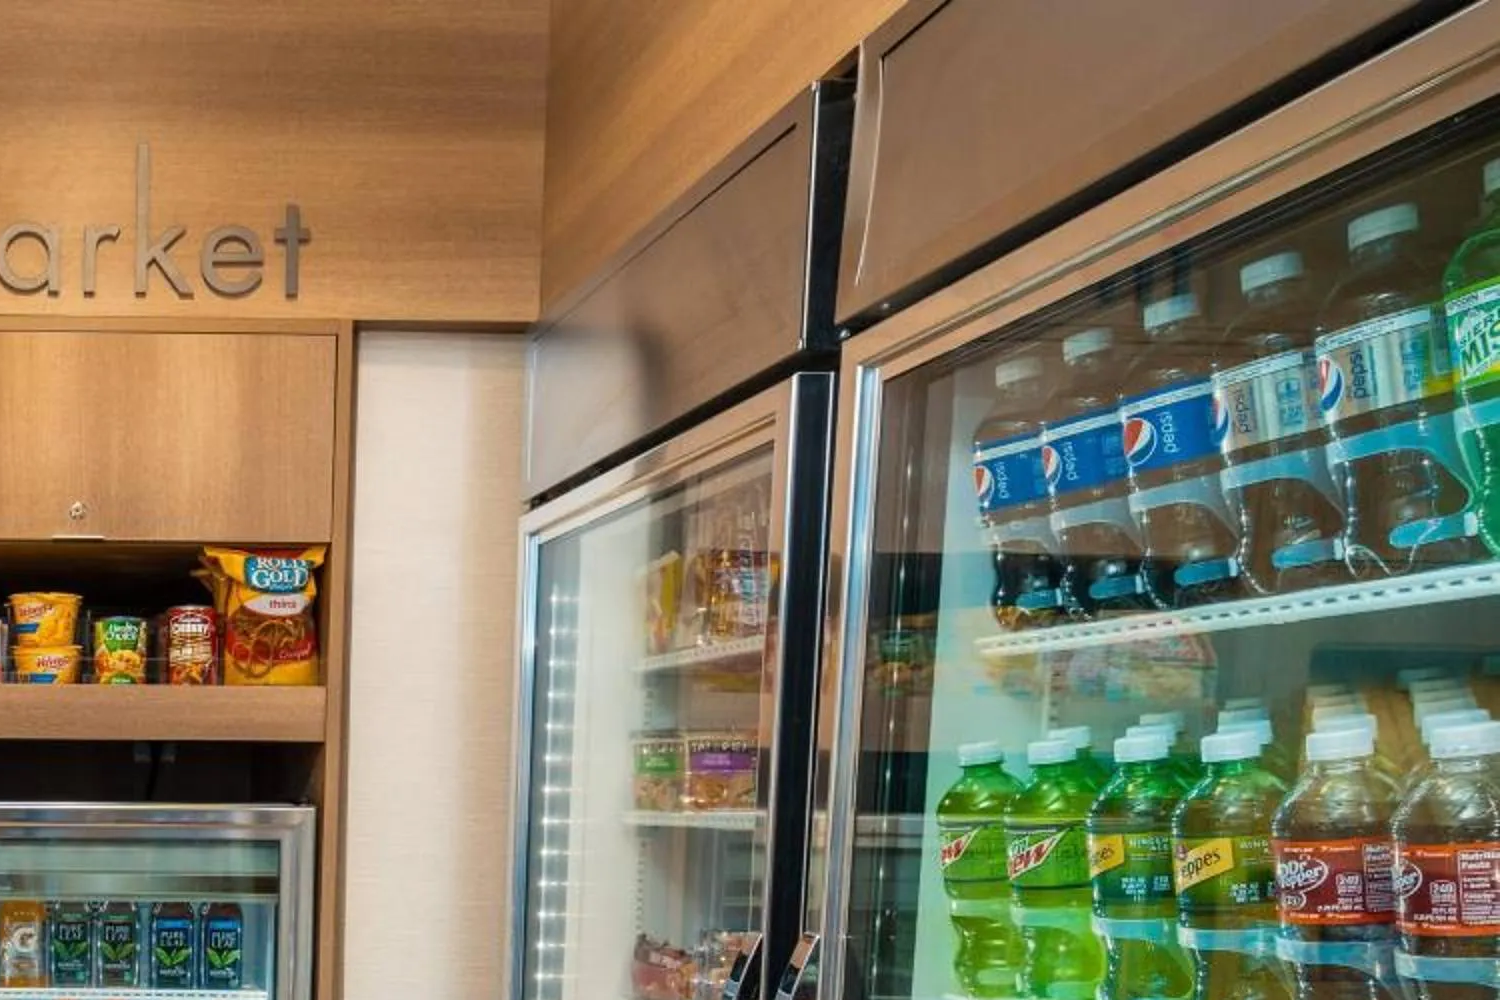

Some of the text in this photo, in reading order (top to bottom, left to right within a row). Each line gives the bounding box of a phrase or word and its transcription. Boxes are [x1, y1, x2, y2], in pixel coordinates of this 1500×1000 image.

[1350, 350, 1368, 398] pepsi
[1159, 411, 1179, 453] pepsi
[1063, 442, 1079, 480] pepsi
[251, 567, 310, 589] GOLD
